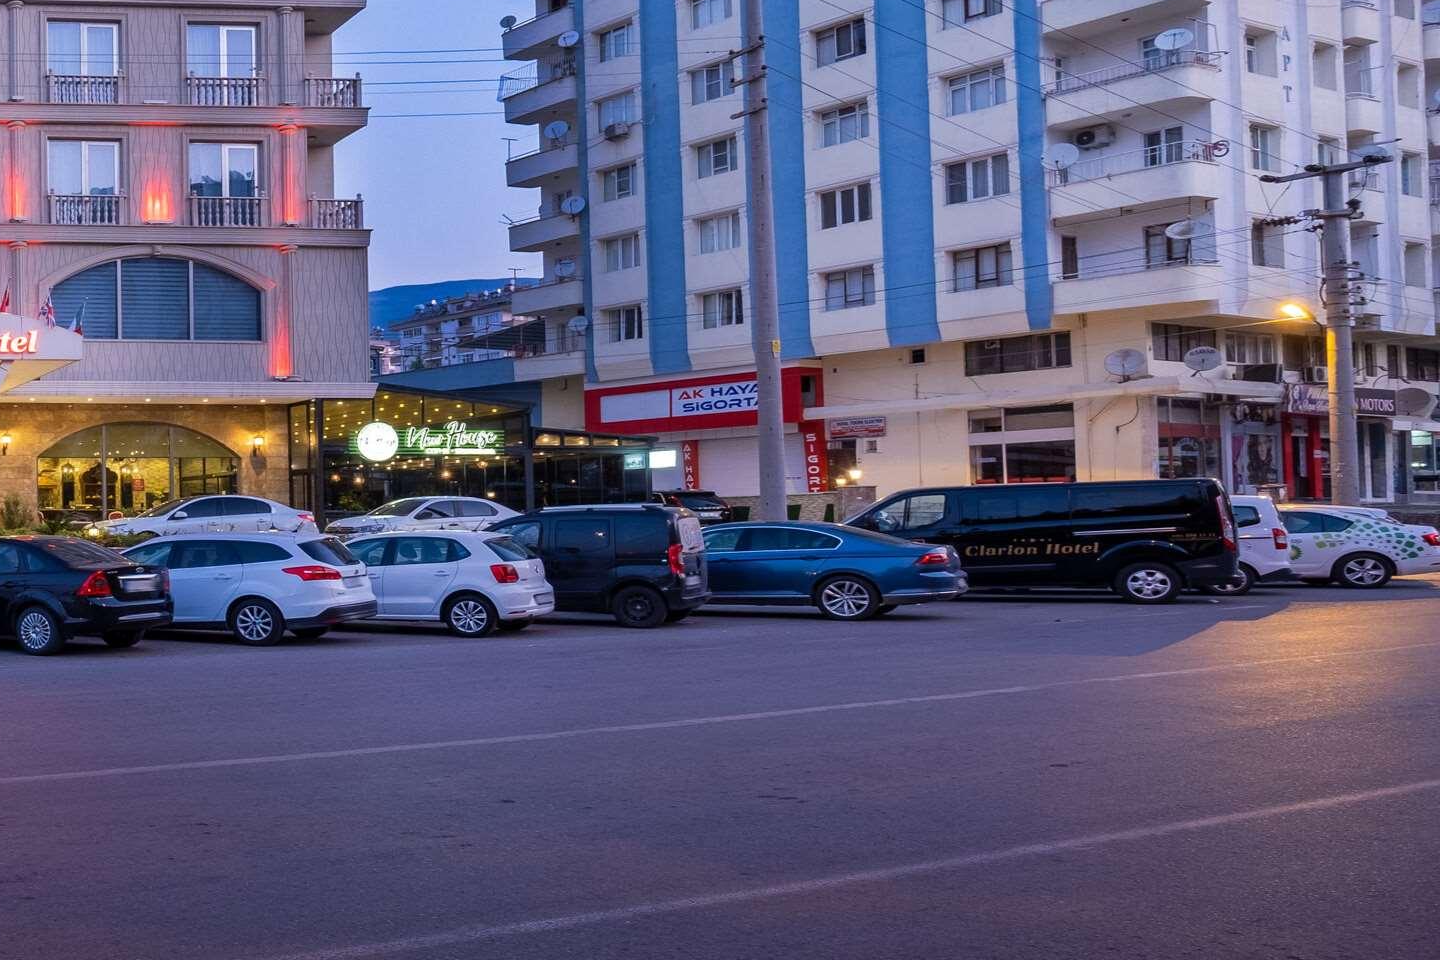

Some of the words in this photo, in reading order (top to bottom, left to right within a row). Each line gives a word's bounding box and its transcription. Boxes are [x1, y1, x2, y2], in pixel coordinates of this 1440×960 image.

[1279, 24, 1293, 103] APT
[678, 390, 705, 401] AK
[710, 383, 758, 397] HAYA
[1360, 398, 1395, 412] MOTORS
[444, 420, 498, 449] House
[685, 465, 696, 489] HAY
[964, 544, 1038, 557] Clarion
[1045, 541, 1100, 555] Hotel
